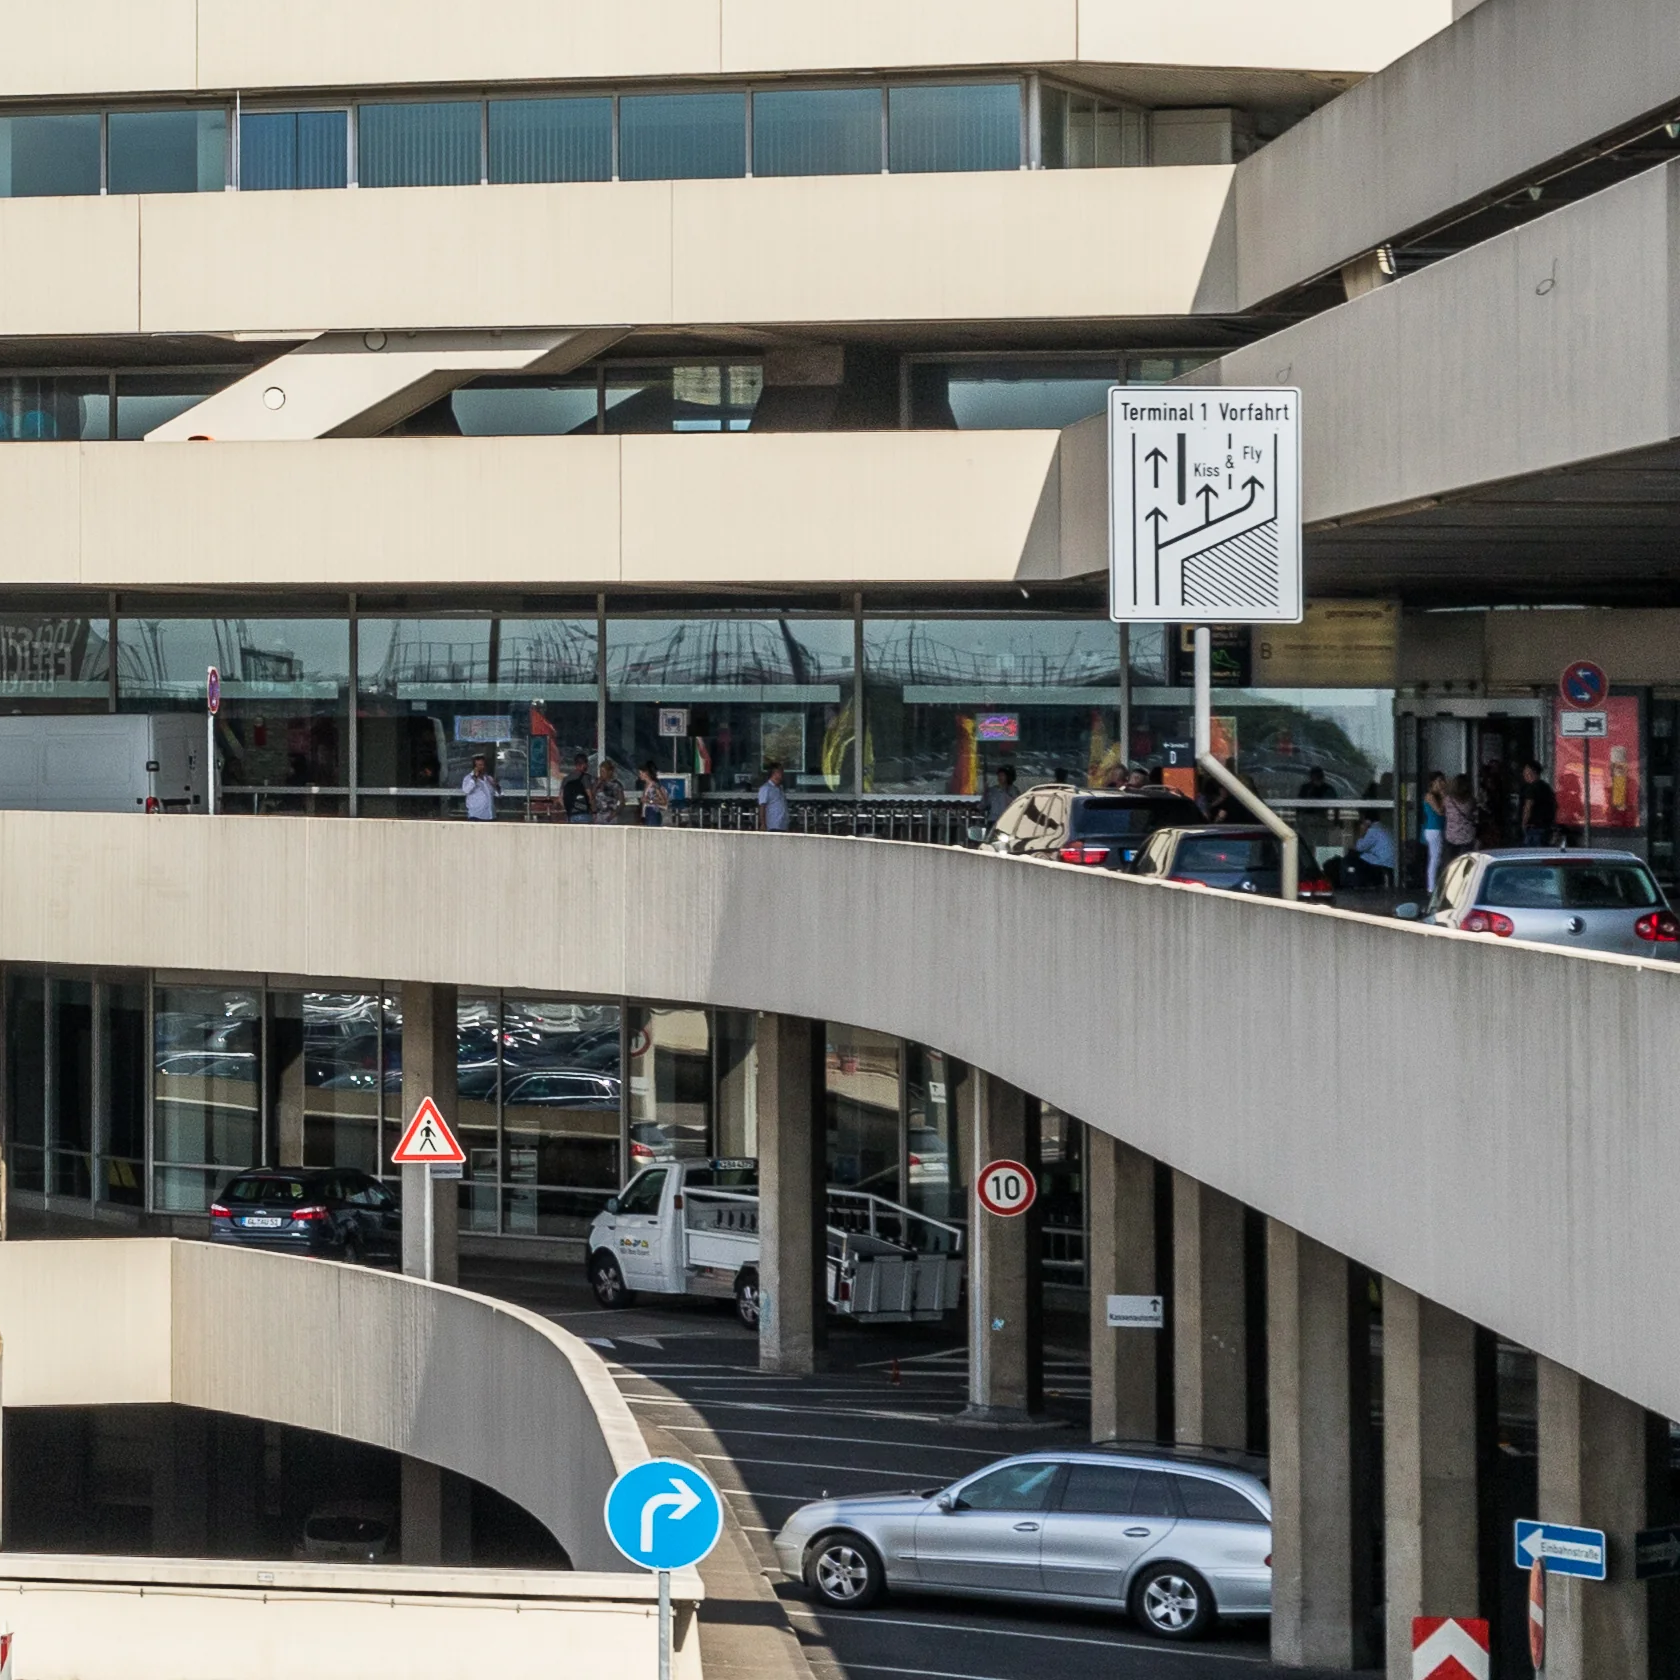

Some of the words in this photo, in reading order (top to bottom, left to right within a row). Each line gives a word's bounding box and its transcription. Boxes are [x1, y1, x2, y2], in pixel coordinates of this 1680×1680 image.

[1121, 402, 1194, 421] Terminal
[1201, 402, 1208, 421] 1
[1219, 402, 1290, 421] Vorfahrt
[1225, 455, 1235, 469] &
[1243, 446, 1263, 464] Fly
[1193, 463, 1220, 477] Kiss
[1170, 750, 1177, 765] D
[992, 1175, 1020, 1200] 10
[1540, 1541, 1600, 1561] Einbahnstraße
